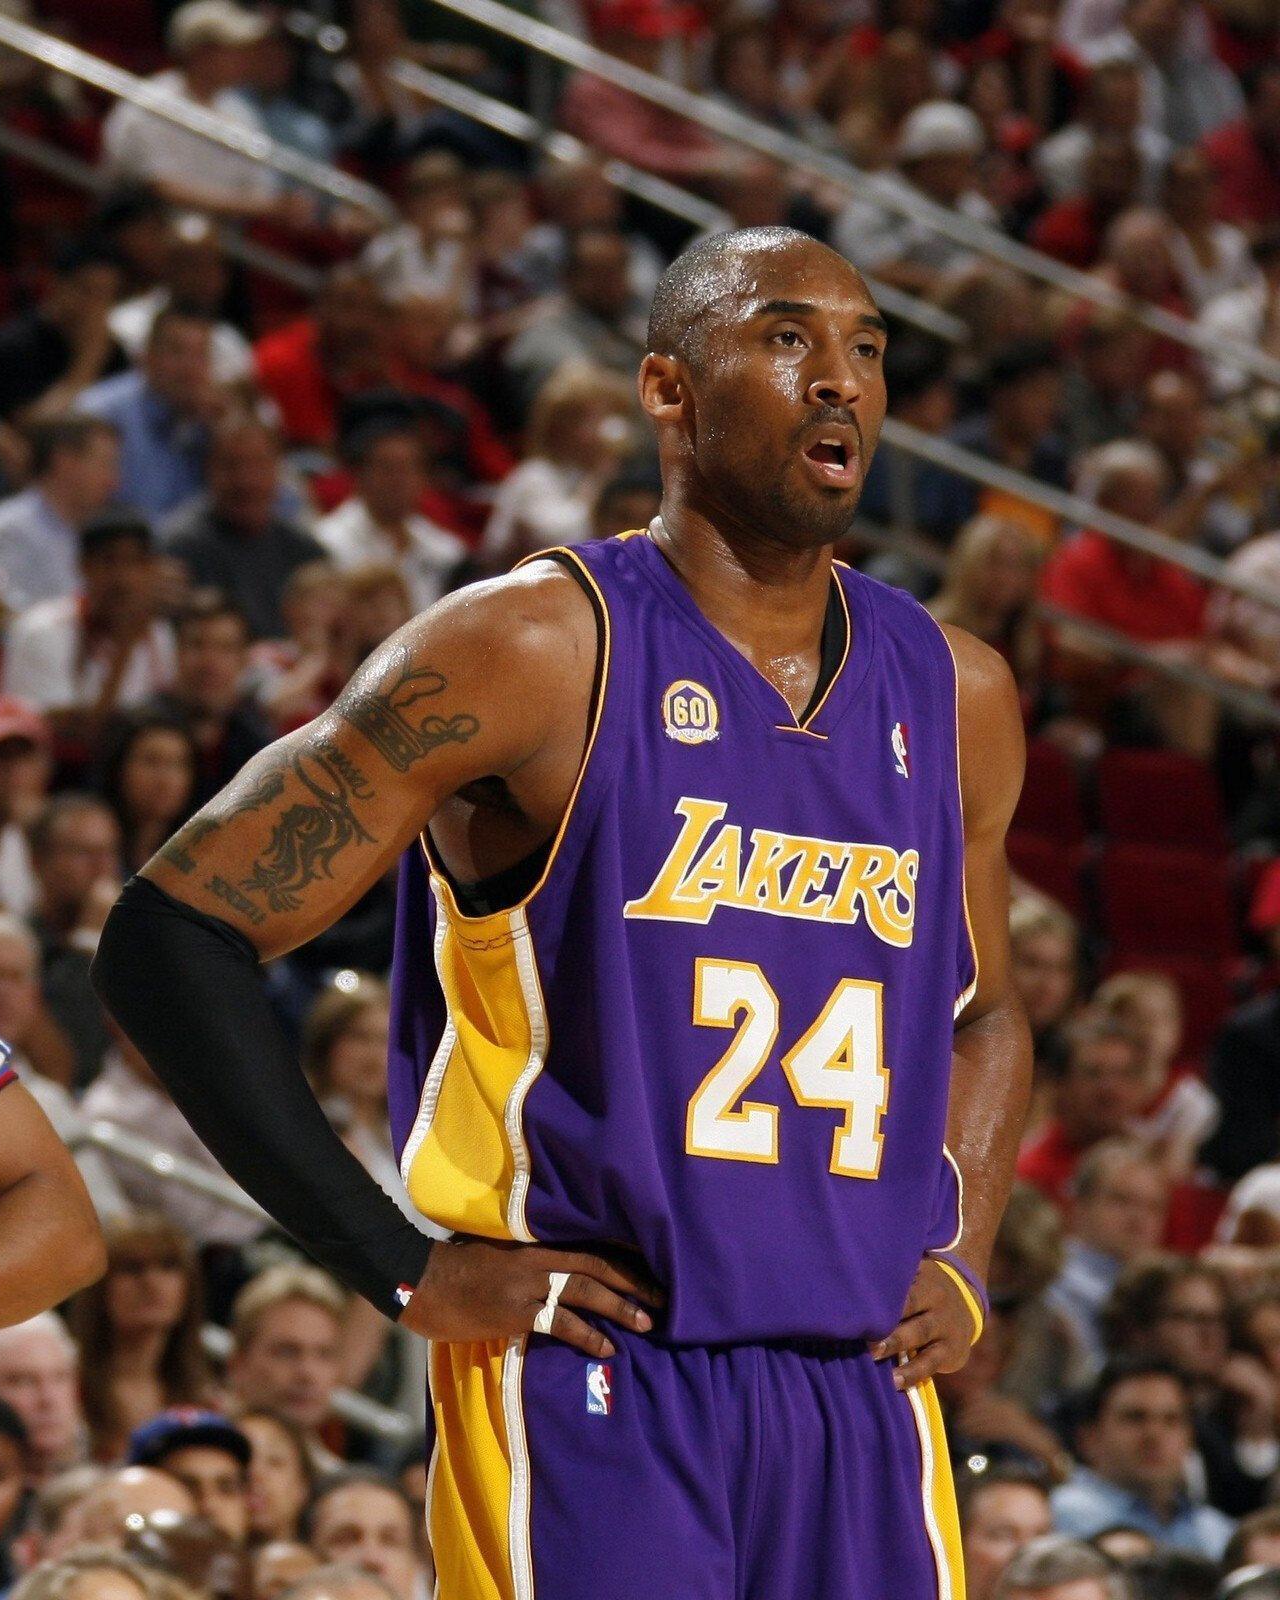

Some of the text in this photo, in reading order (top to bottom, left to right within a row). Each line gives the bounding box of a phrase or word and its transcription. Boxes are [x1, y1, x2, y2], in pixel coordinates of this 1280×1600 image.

[673, 695, 706, 727] 60
[623, 796, 919, 948] LAKERS
[685, 957, 891, 1180] 24
